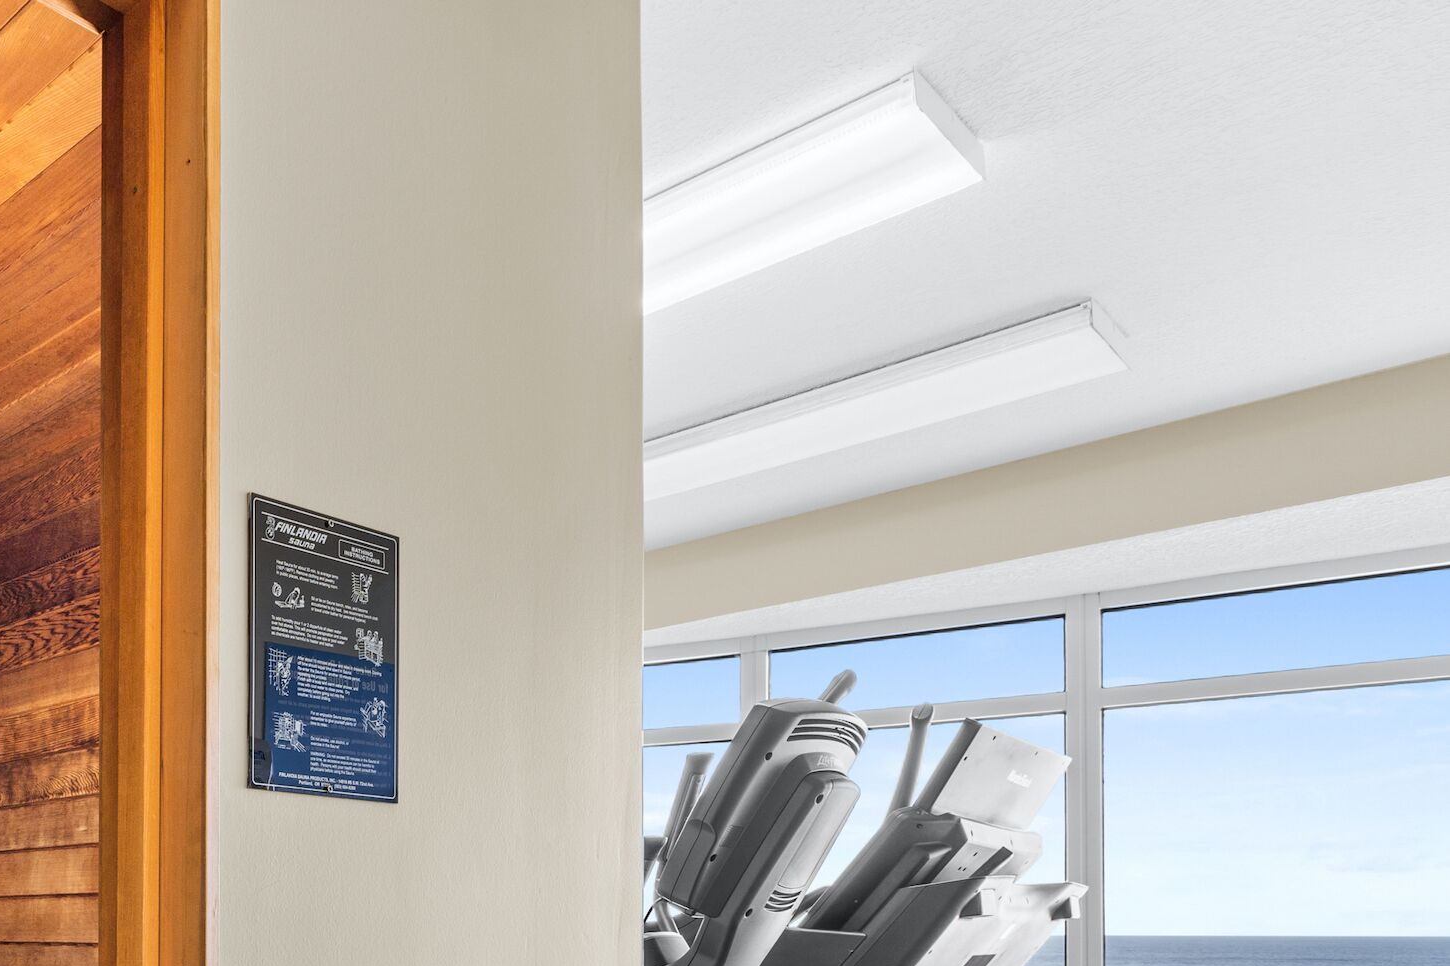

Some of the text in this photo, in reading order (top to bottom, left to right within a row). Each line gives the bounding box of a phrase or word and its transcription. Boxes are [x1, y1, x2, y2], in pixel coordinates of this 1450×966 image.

[275, 521, 328, 545] FINLANDIA
[288, 537, 316, 550] sauna
[343, 550, 381, 566] INSTRUCTIONS
[351, 546, 374, 558] BATHING
